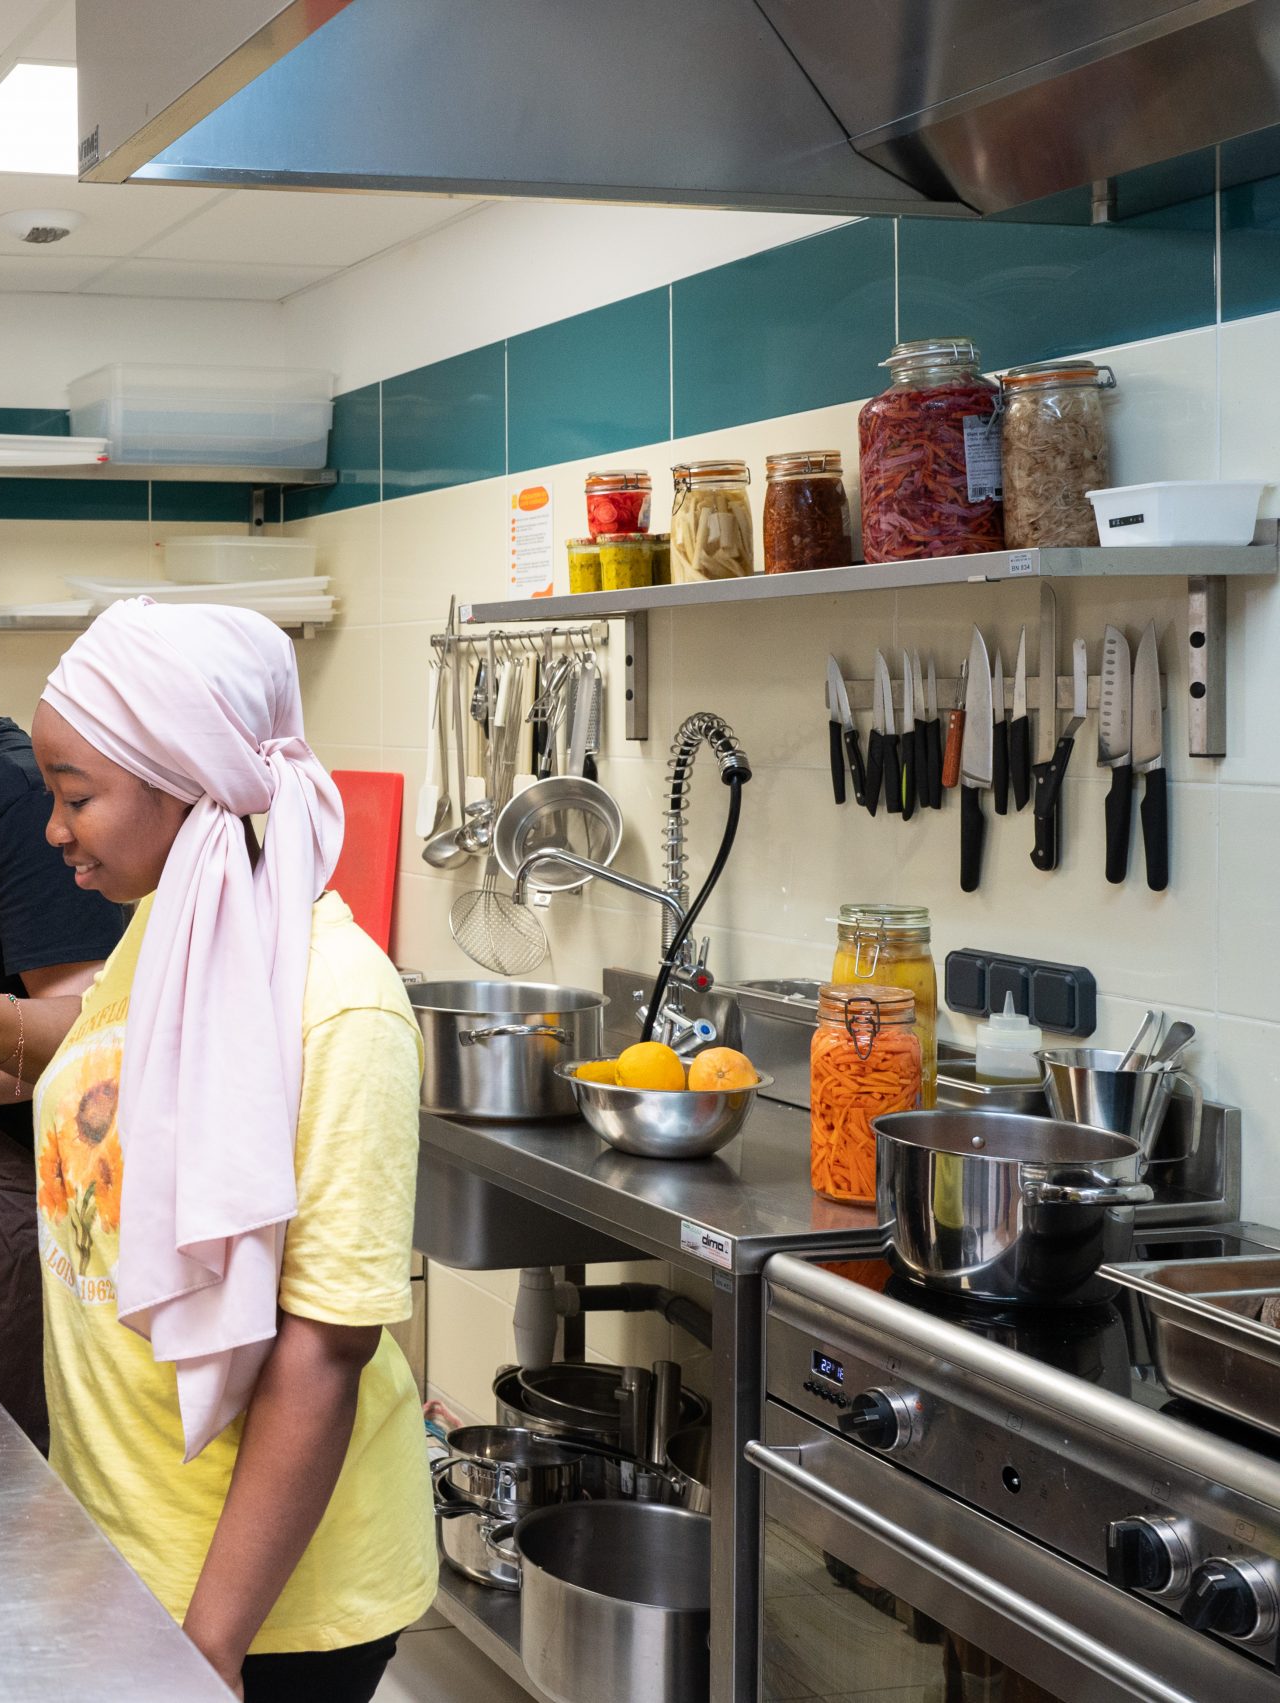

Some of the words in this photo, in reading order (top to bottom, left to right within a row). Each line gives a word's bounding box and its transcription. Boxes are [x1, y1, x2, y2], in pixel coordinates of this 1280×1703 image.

[65, 996, 128, 1050] SUNFLO
[702, 1233, 724, 1252] dima
[47, 1247, 76, 1287] LOIS
[80, 1279, 115, 1301] 1962
